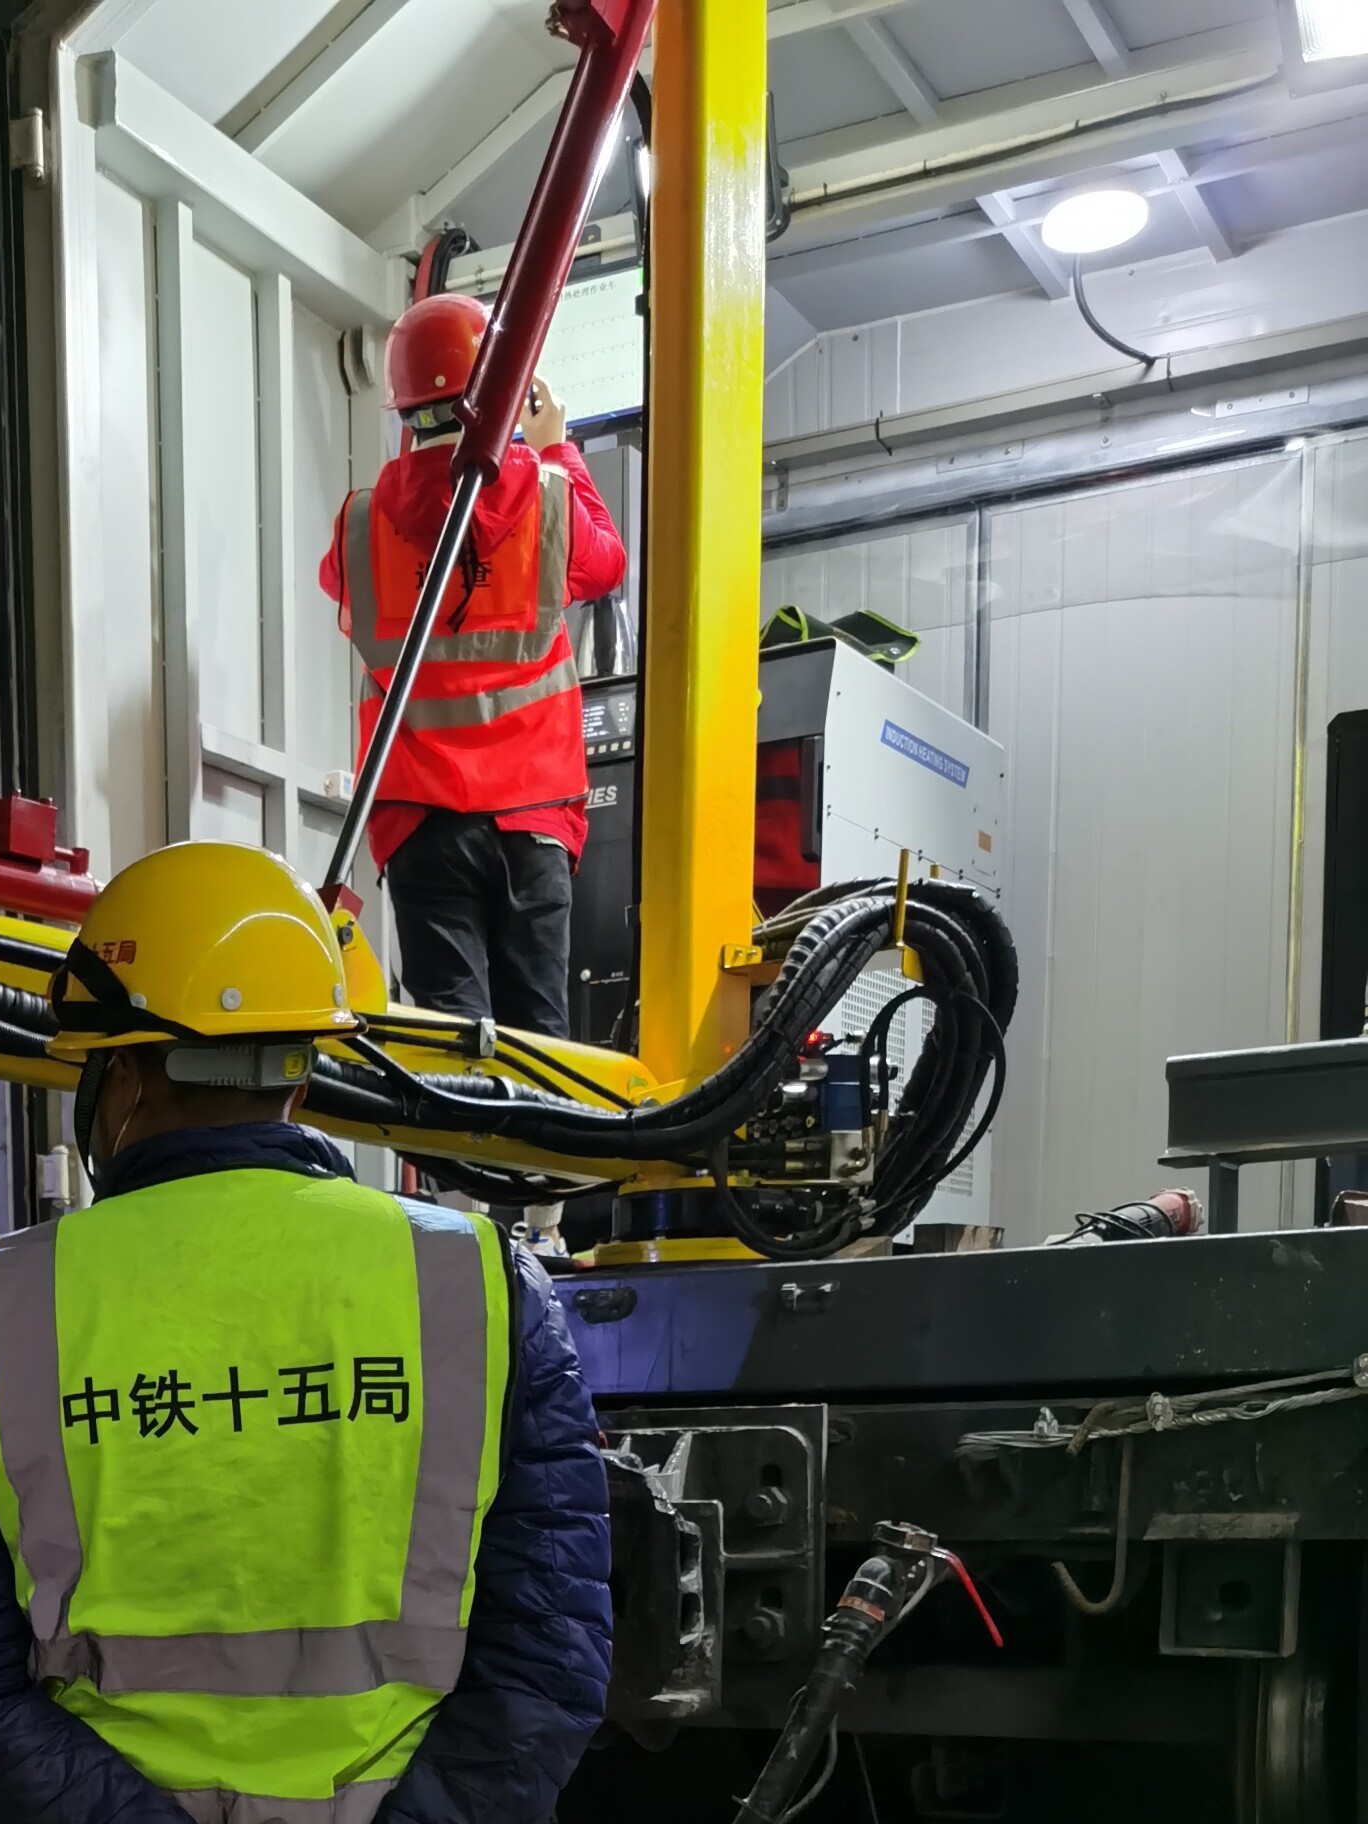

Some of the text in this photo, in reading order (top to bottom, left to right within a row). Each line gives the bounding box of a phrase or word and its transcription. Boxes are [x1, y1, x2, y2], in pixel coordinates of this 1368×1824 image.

[884, 725, 919, 757] INDUCTION
[943, 757, 967, 783] SYSTEM
[62, 1356, 411, 1445] 中铁十五局
